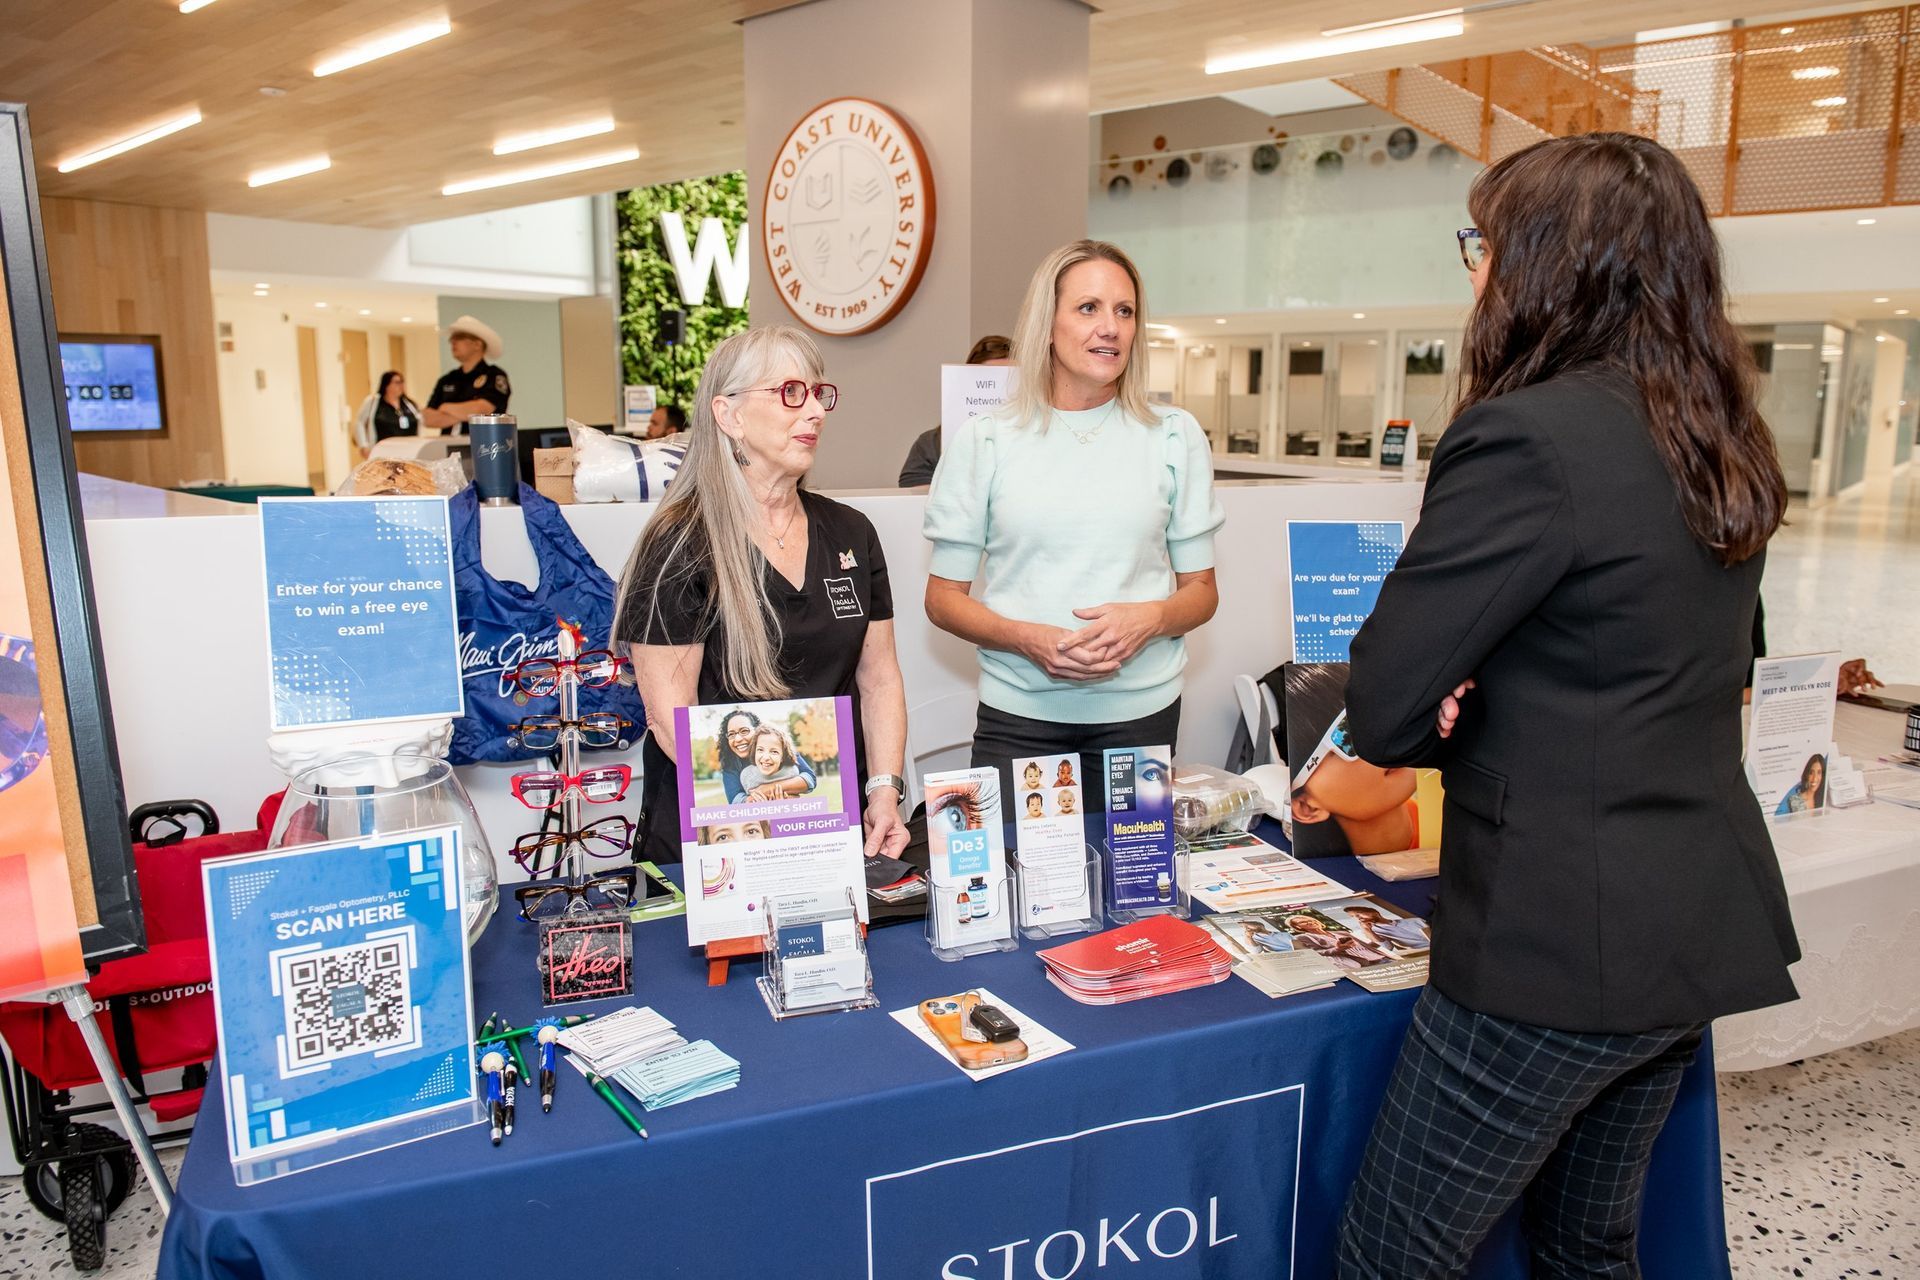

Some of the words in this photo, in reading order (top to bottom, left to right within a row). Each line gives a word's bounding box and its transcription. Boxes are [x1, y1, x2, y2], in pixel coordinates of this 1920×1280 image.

[774, 114, 834, 201] COAST
[848, 112, 914, 296] UNIVERSITY
[771, 222, 802, 301] WEST
[814, 302, 837, 319] EST
[841, 300, 868, 319] 1909
[975, 380, 996, 389] WIFI
[1294, 574, 1309, 582] Are
[1311, 575, 1327, 583] you
[1329, 573, 1346, 582] due
[1348, 573, 1360, 582] for
[1362, 574, 1381, 583] your
[276, 584, 319, 597] Enter
[323, 581, 346, 595] for
[351, 581, 384, 597] your
[389, 579, 443, 592] chance
[1332, 587, 1360, 596] exam?
[295, 605, 312, 617] to
[317, 602, 345, 616] win
[351, 605, 360, 614] a
[365, 600, 396, 614] free
[401, 601, 428, 615] eye
[1295, 613, 1317, 622] We'll
[1319, 613, 1331, 622] be
[1333, 613, 1352, 625] glad
[1354, 614, 1364, 622] to
[338, 622, 385, 637] exam!
[1790, 684, 1815, 692] KEVELYN
[1111, 755, 1134, 763] MAINTAIN
[1111, 763, 1132, 771] HEALTHY
[1112, 787, 1134, 795] ENHANCE
[1112, 795, 1125, 803] YOUR
[696, 809, 727, 822] MAKE
[728, 804, 791, 819] CHILDREN'S
[793, 801, 823, 812] SIGHT
[1112, 803, 1128, 811] VISION
[776, 822, 806, 833] YOUR
[959, 856, 980, 864] Omega
[270, 909, 299, 921] Stokol
[308, 902, 338, 914] Fagala
[339, 894, 386, 909] Optometry,
[387, 889, 411, 900] PLLC
[276, 913, 343, 941] SCAN
[348, 902, 406, 928] HERE
[788, 936, 816, 945] STOKOL
[583, 978, 613, 987] eyewear
[645, 1057, 669, 1066] ENTER
[505, 1086, 515, 1106] HOYA
[941, 1195, 1238, 1280] STOKOL
